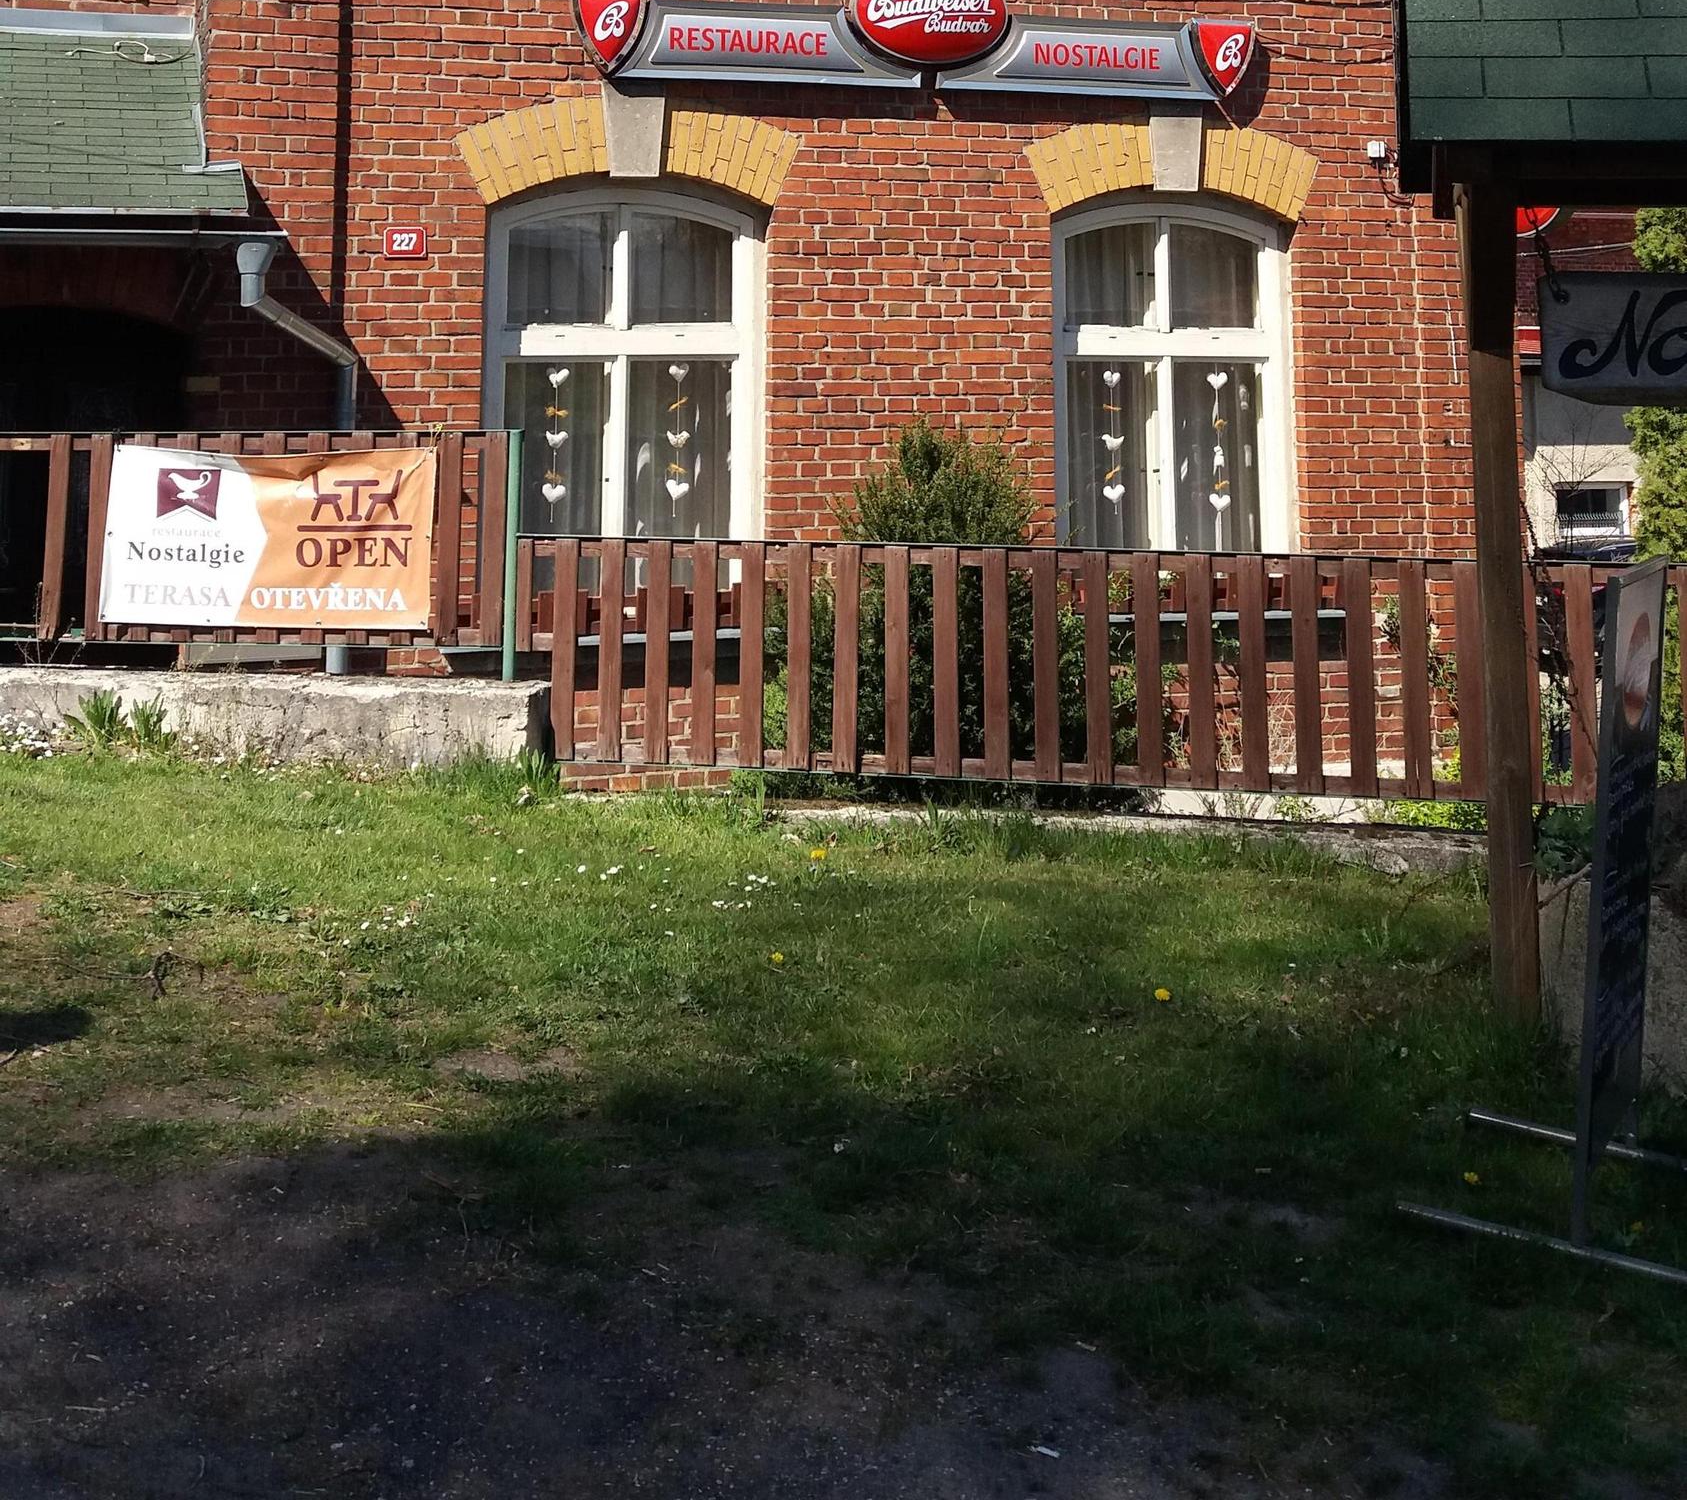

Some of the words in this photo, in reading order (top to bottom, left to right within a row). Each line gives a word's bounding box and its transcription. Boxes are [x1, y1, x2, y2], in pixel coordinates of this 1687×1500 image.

[924, 11, 993, 34] Budvar
[669, 26, 828, 57] RESTAURACE
[1034, 42, 1161, 70] NOSTALGIE
[392, 233, 417, 251] 227
[152, 527, 221, 538] restaurace
[127, 541, 245, 569] Nostalgie
[295, 536, 412, 568] OPEN
[124, 583, 232, 607] TERASA
[250, 582, 408, 612] OTEVŘENA
